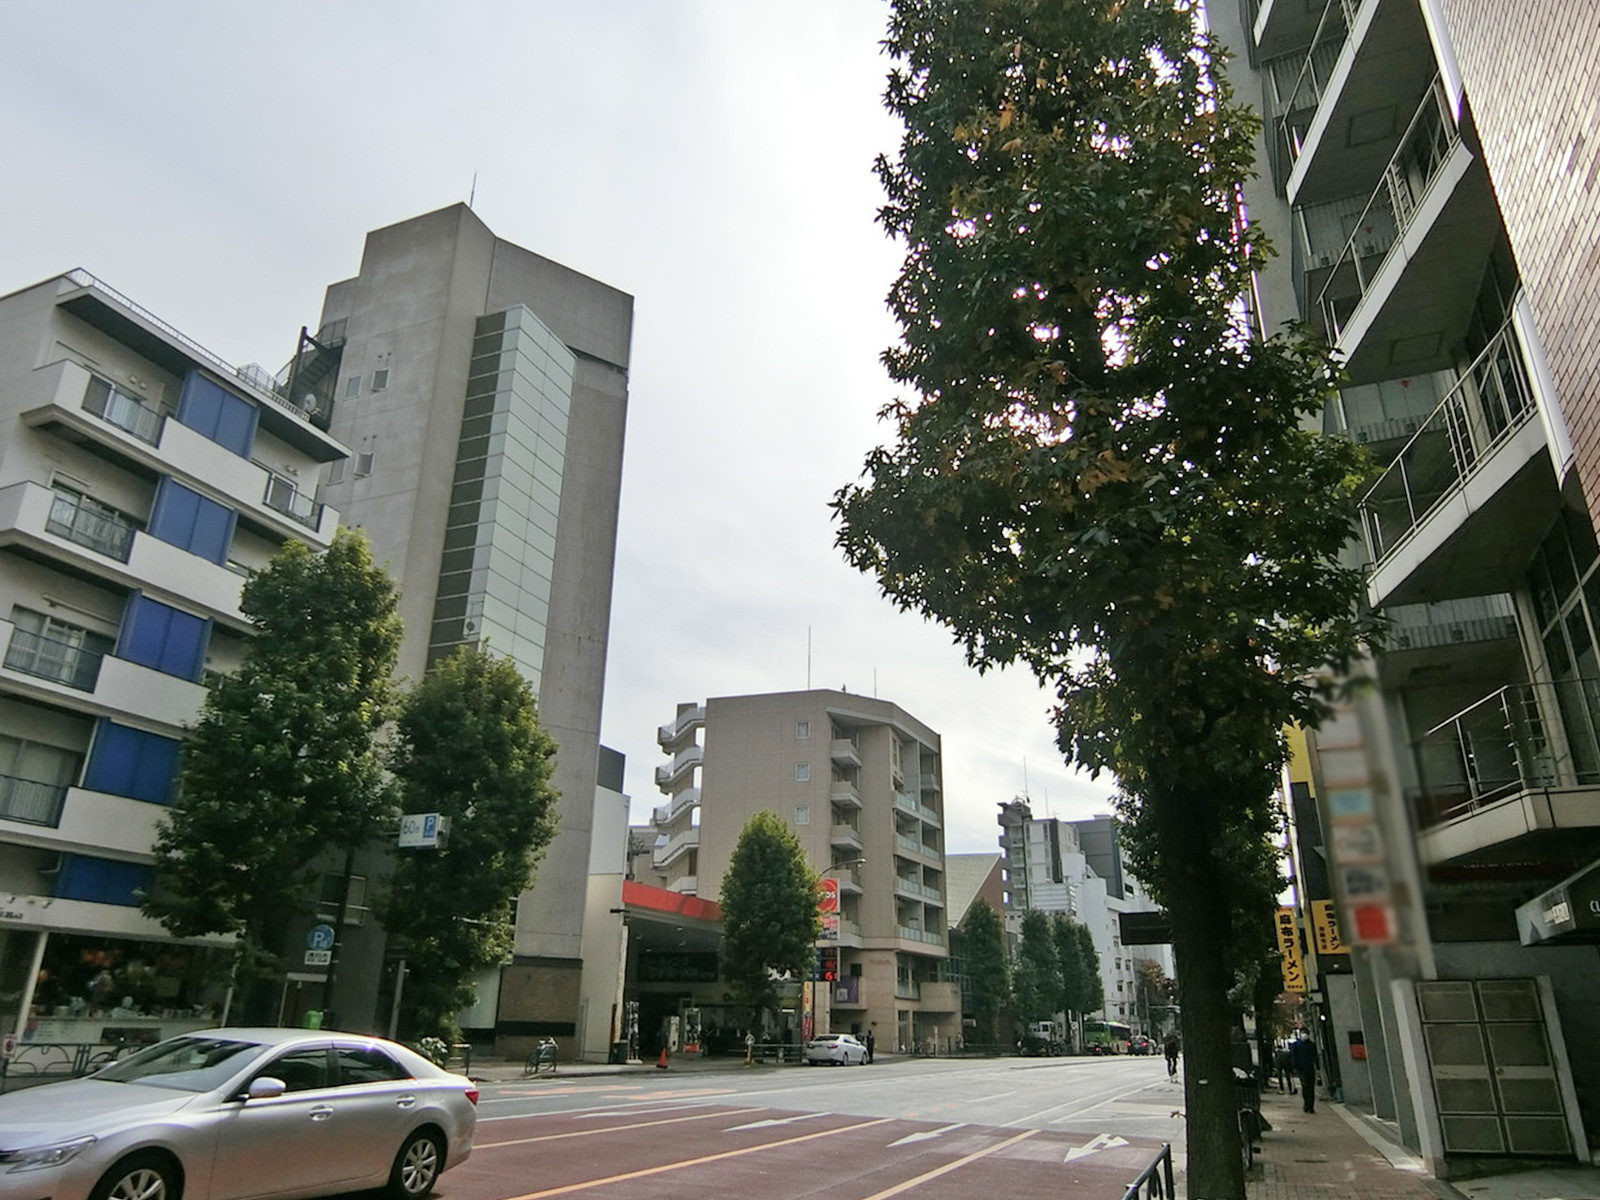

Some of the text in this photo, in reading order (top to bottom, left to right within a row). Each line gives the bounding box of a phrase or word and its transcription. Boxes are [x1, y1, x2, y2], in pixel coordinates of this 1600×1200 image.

[426, 816, 435, 830] P
[313, 931, 325, 947] P
[1279, 914, 1300, 982] 麻布ラーメン
